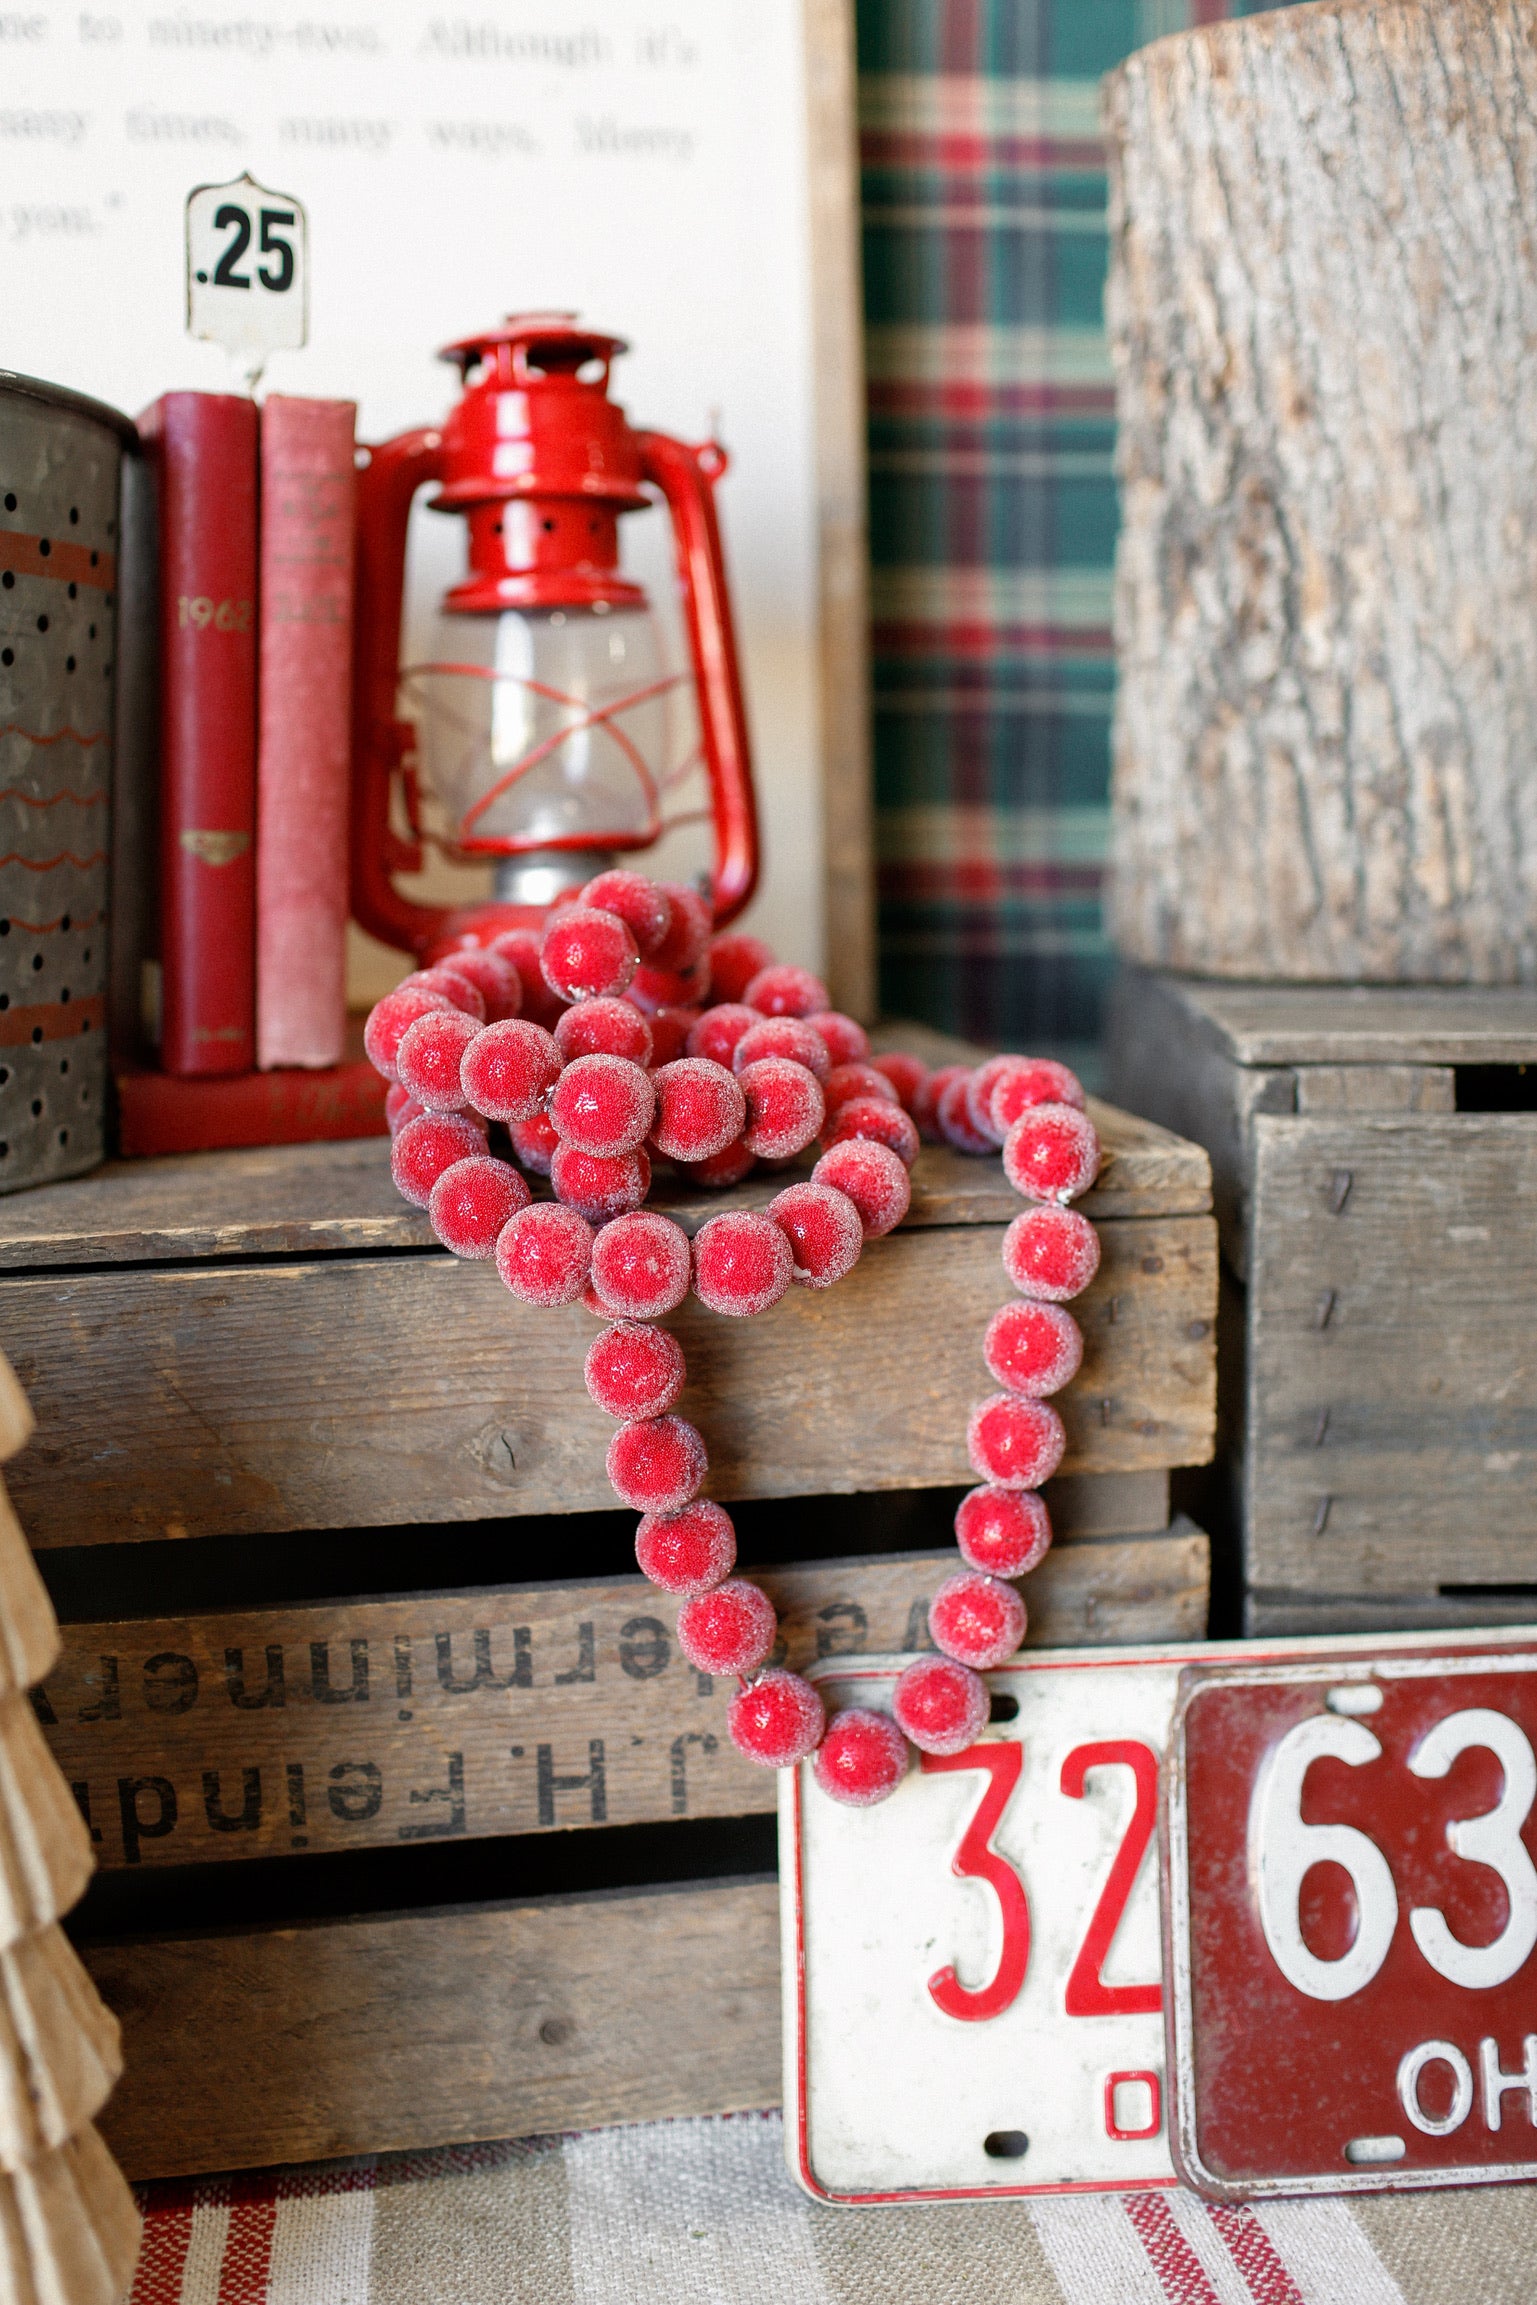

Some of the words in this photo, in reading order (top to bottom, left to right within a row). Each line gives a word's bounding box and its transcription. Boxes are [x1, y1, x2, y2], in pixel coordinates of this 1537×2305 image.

[194, 206, 294, 291] .25
[921, 1740, 1163, 2022] 32
[1248, 1707, 1537, 2003] 63
[1397, 2034, 1537, 2135] OH
